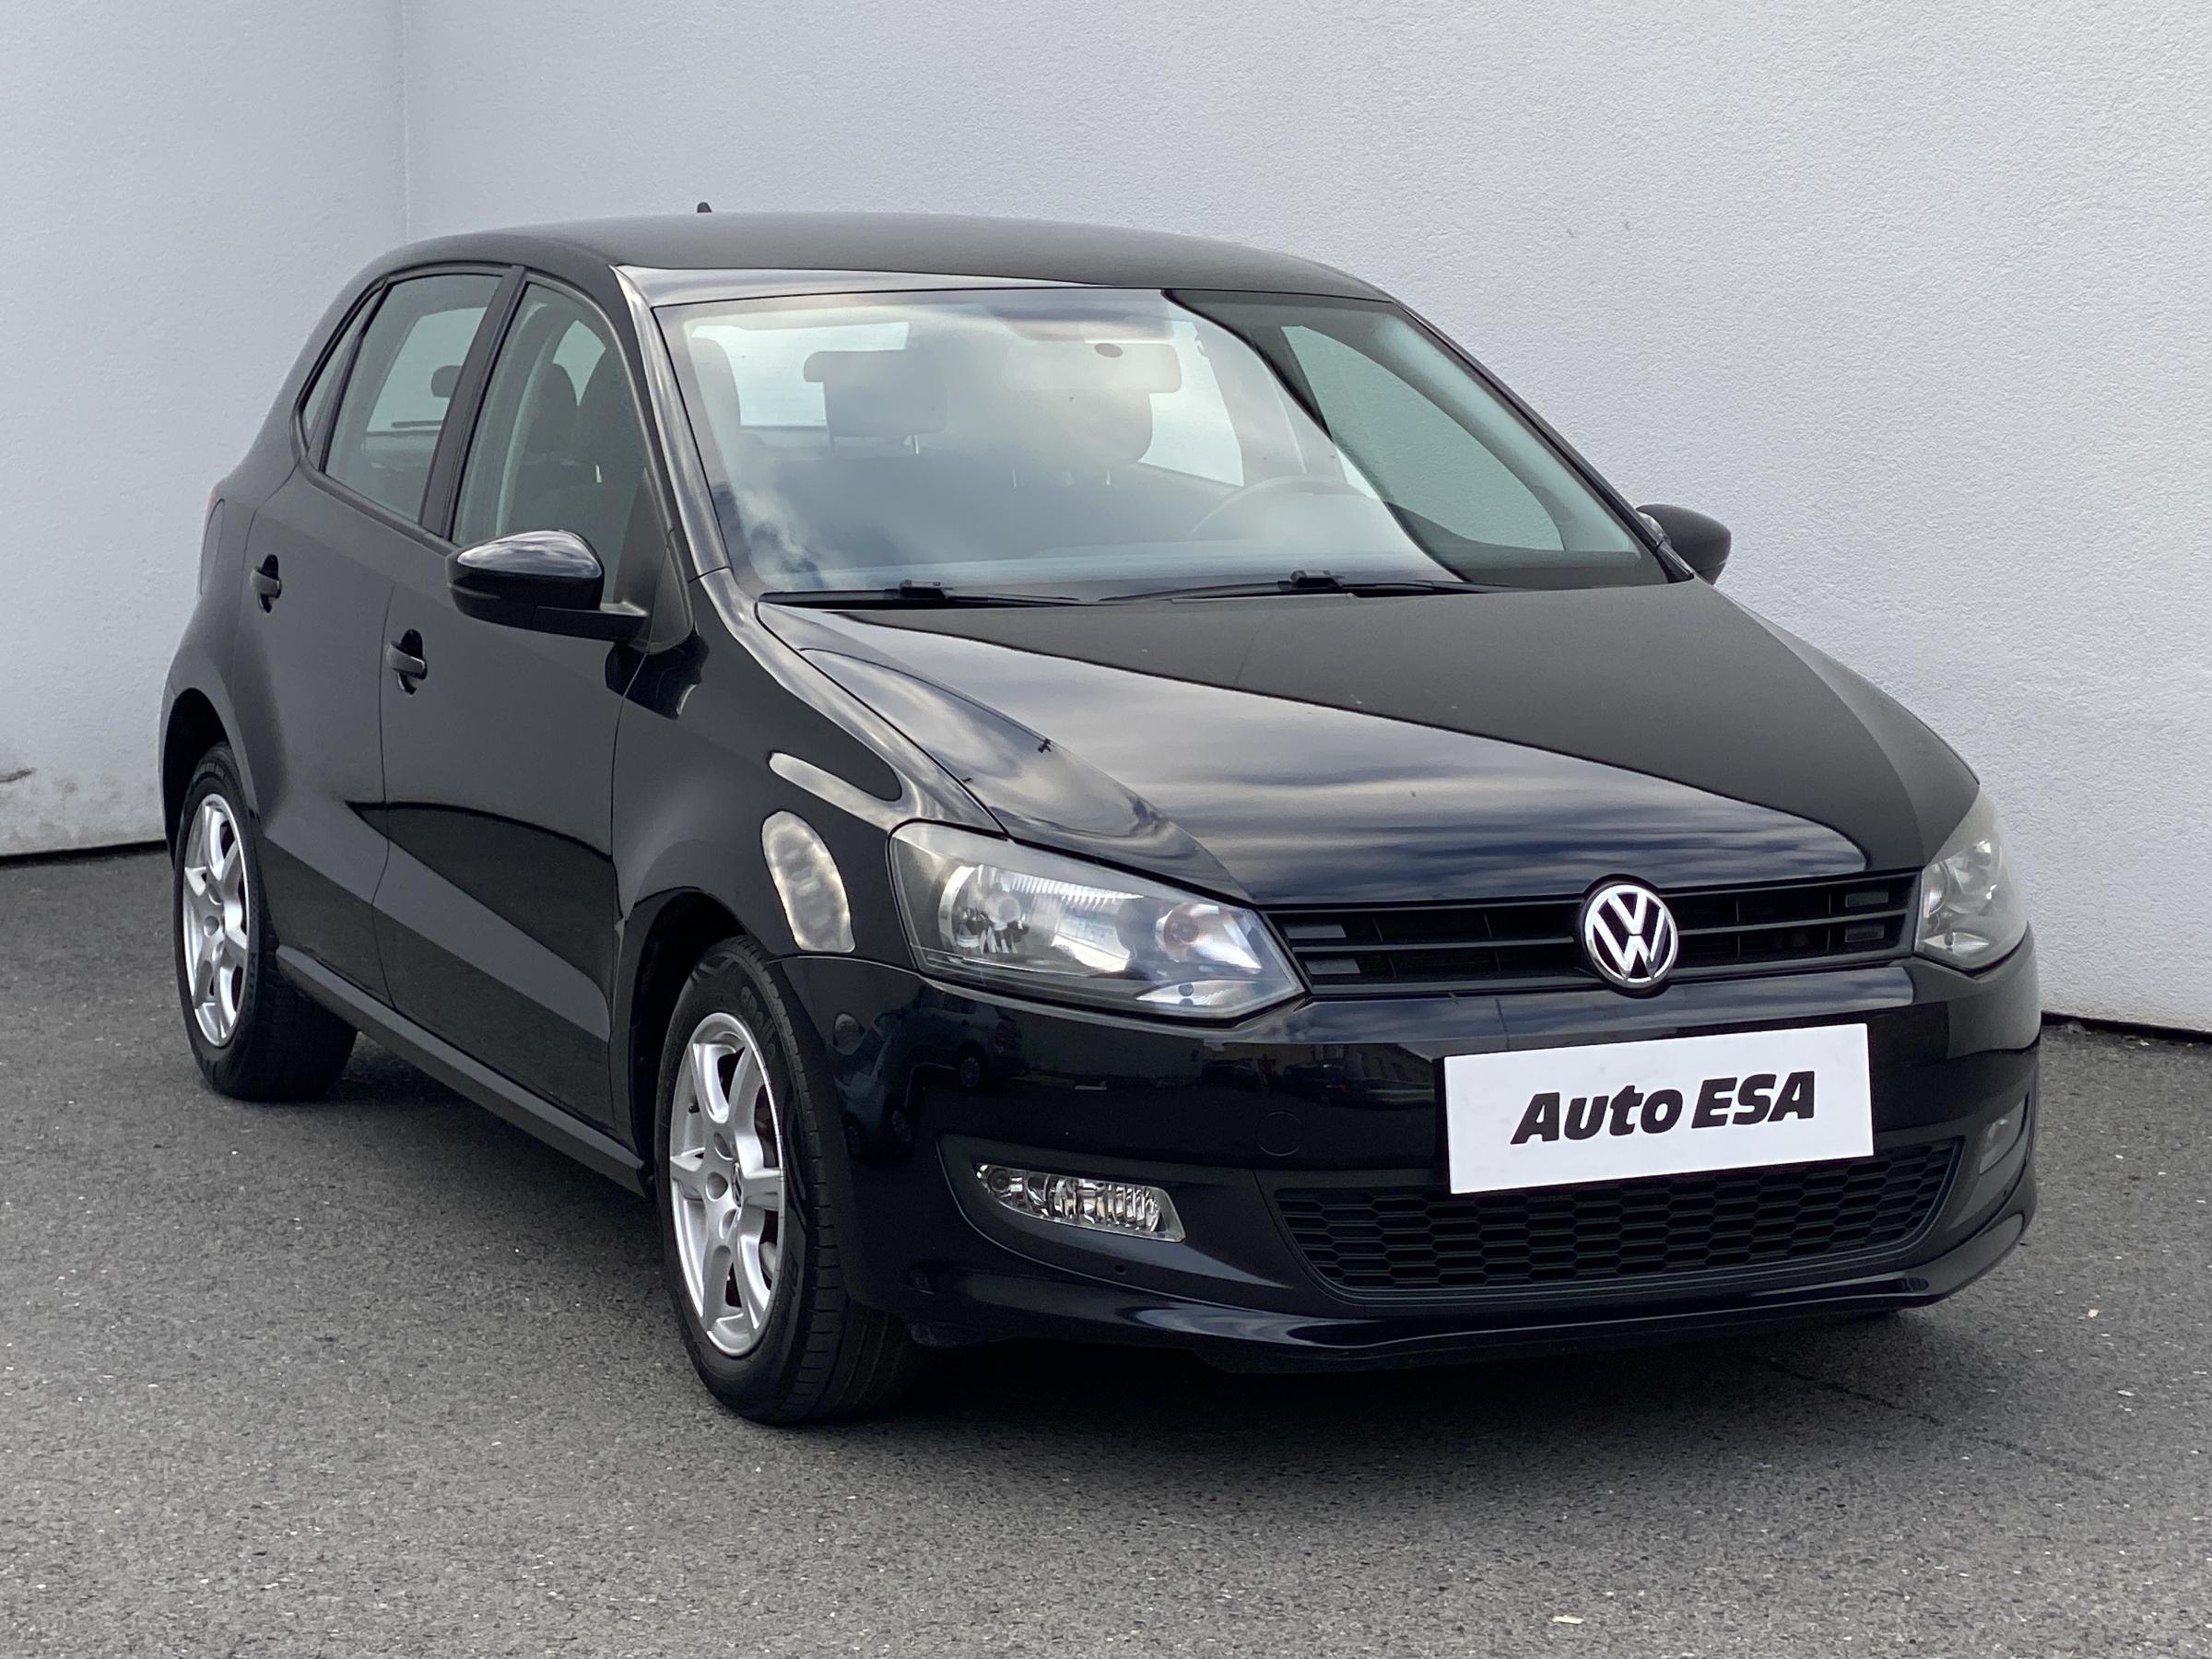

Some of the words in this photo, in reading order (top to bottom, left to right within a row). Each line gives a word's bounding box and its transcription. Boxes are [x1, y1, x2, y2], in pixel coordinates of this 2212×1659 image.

[1586, 885, 1677, 984] VW
[1511, 1085, 1684, 1145] Auto
[1690, 1070, 1815, 1129] ESA
